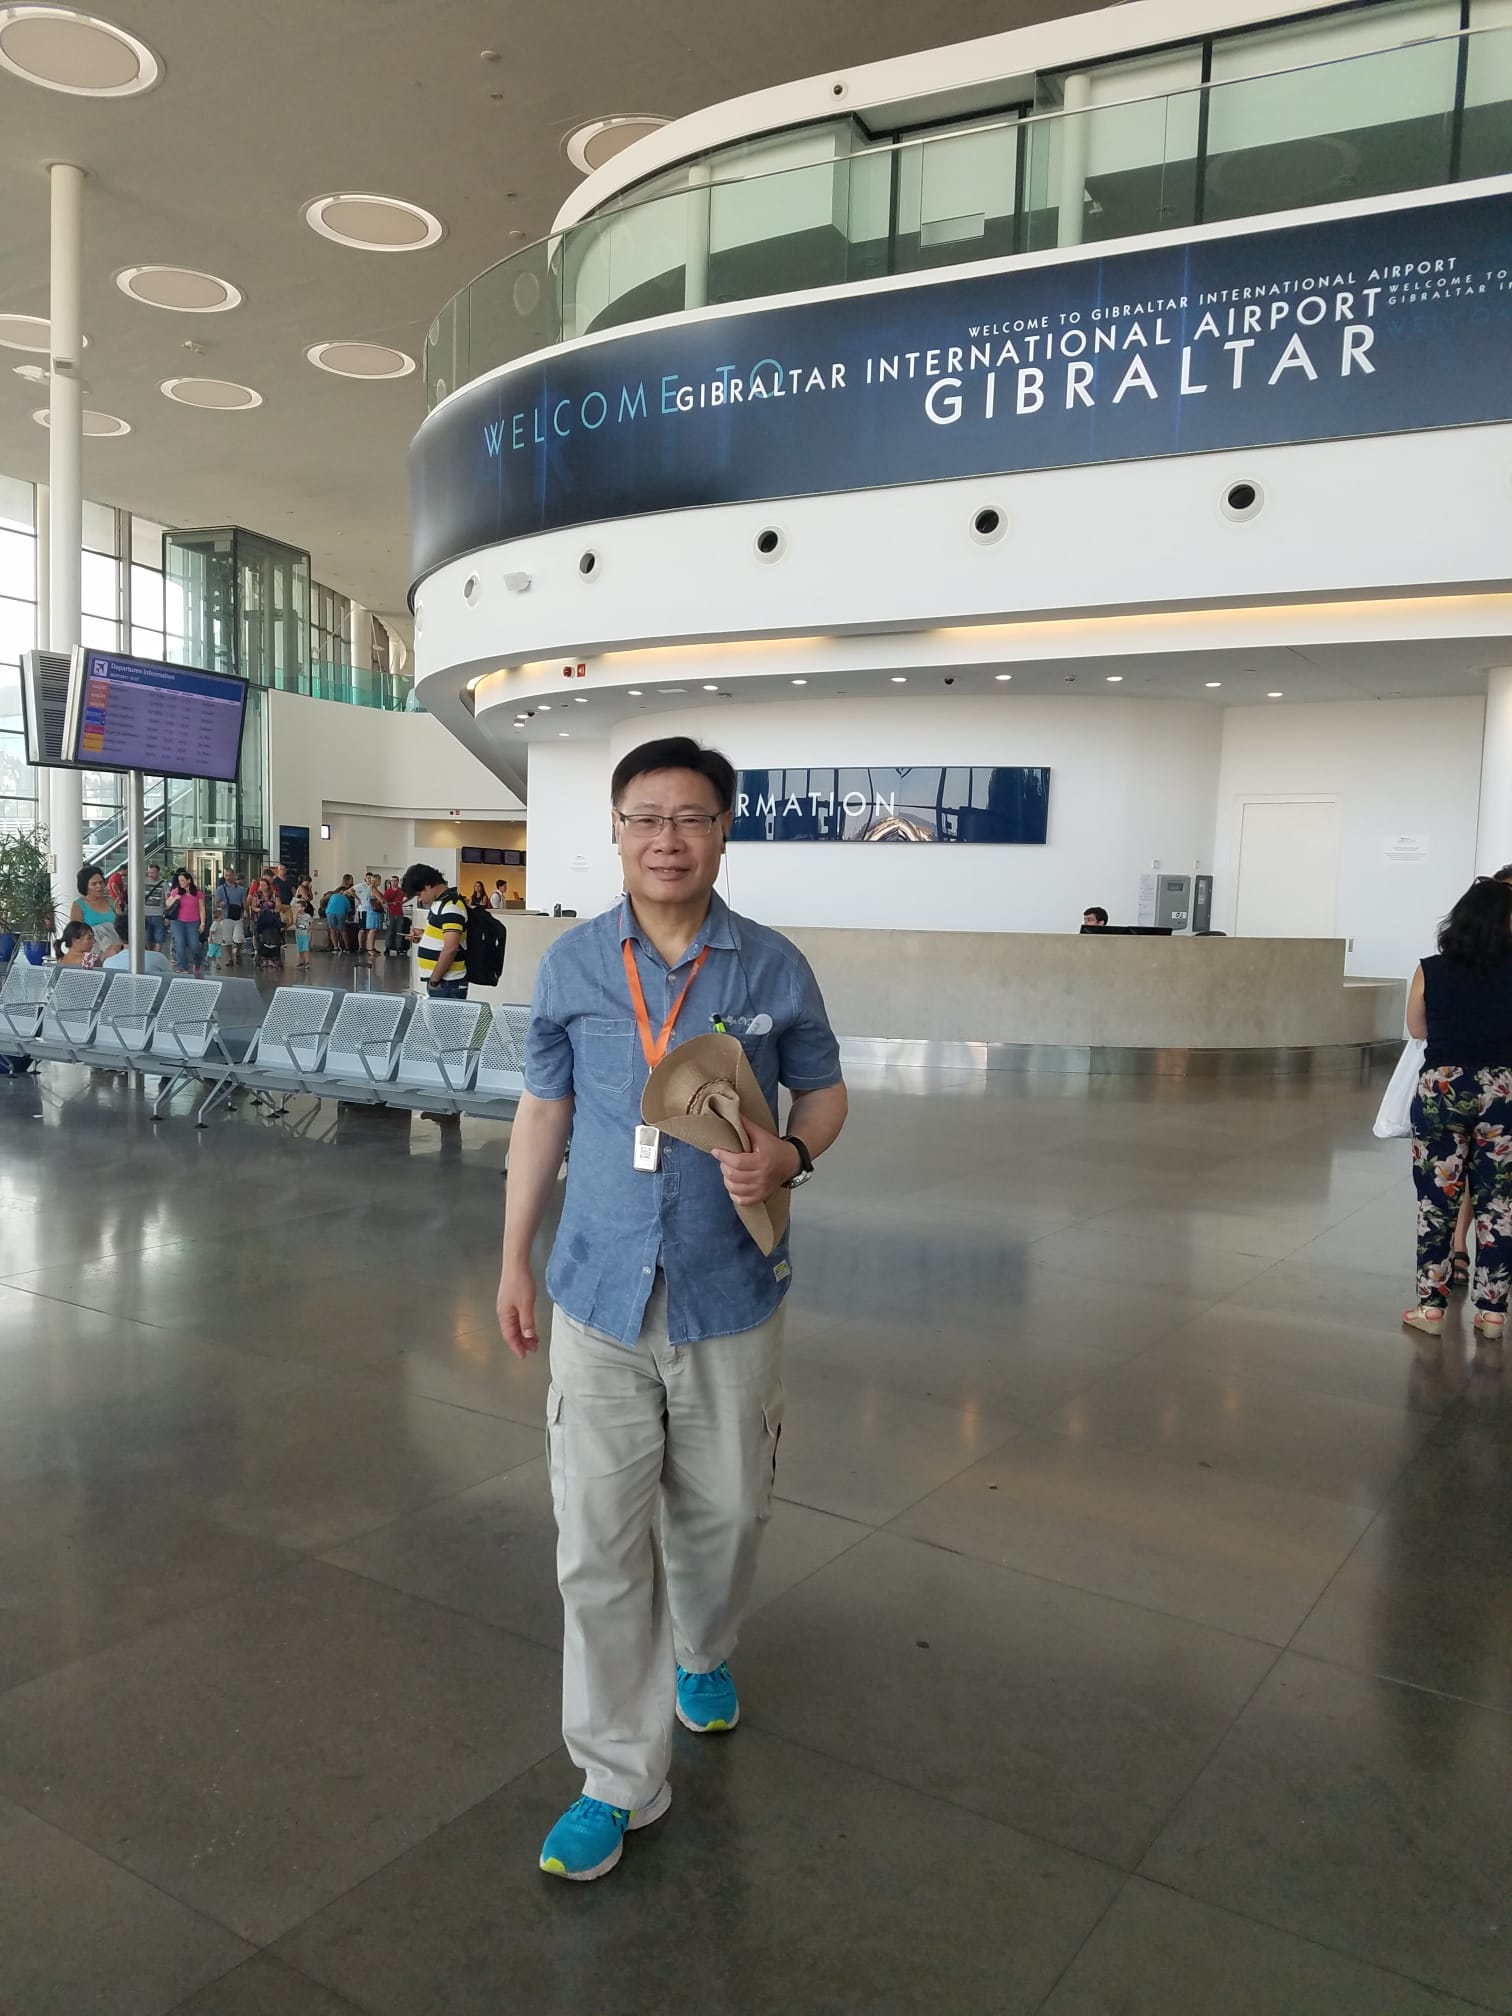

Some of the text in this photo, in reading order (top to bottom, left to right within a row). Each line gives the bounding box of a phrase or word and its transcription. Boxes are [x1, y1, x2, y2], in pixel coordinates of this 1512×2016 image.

[968, 257, 1457, 338] WELCOME TO GIBRALTAR INTERNATIONAL AIRPORT
[1388, 284, 1486, 305] GIBRALTAR
[1389, 270, 1507, 293] WELCOME TO
[676, 287, 1382, 412] GIBRALTAR INTERNATIONAL AIRPORT
[924, 324, 1377, 426] GIBRALTAR
[483, 358, 784, 458] WELCOME TO
[737, 791, 895, 817] RMATION
